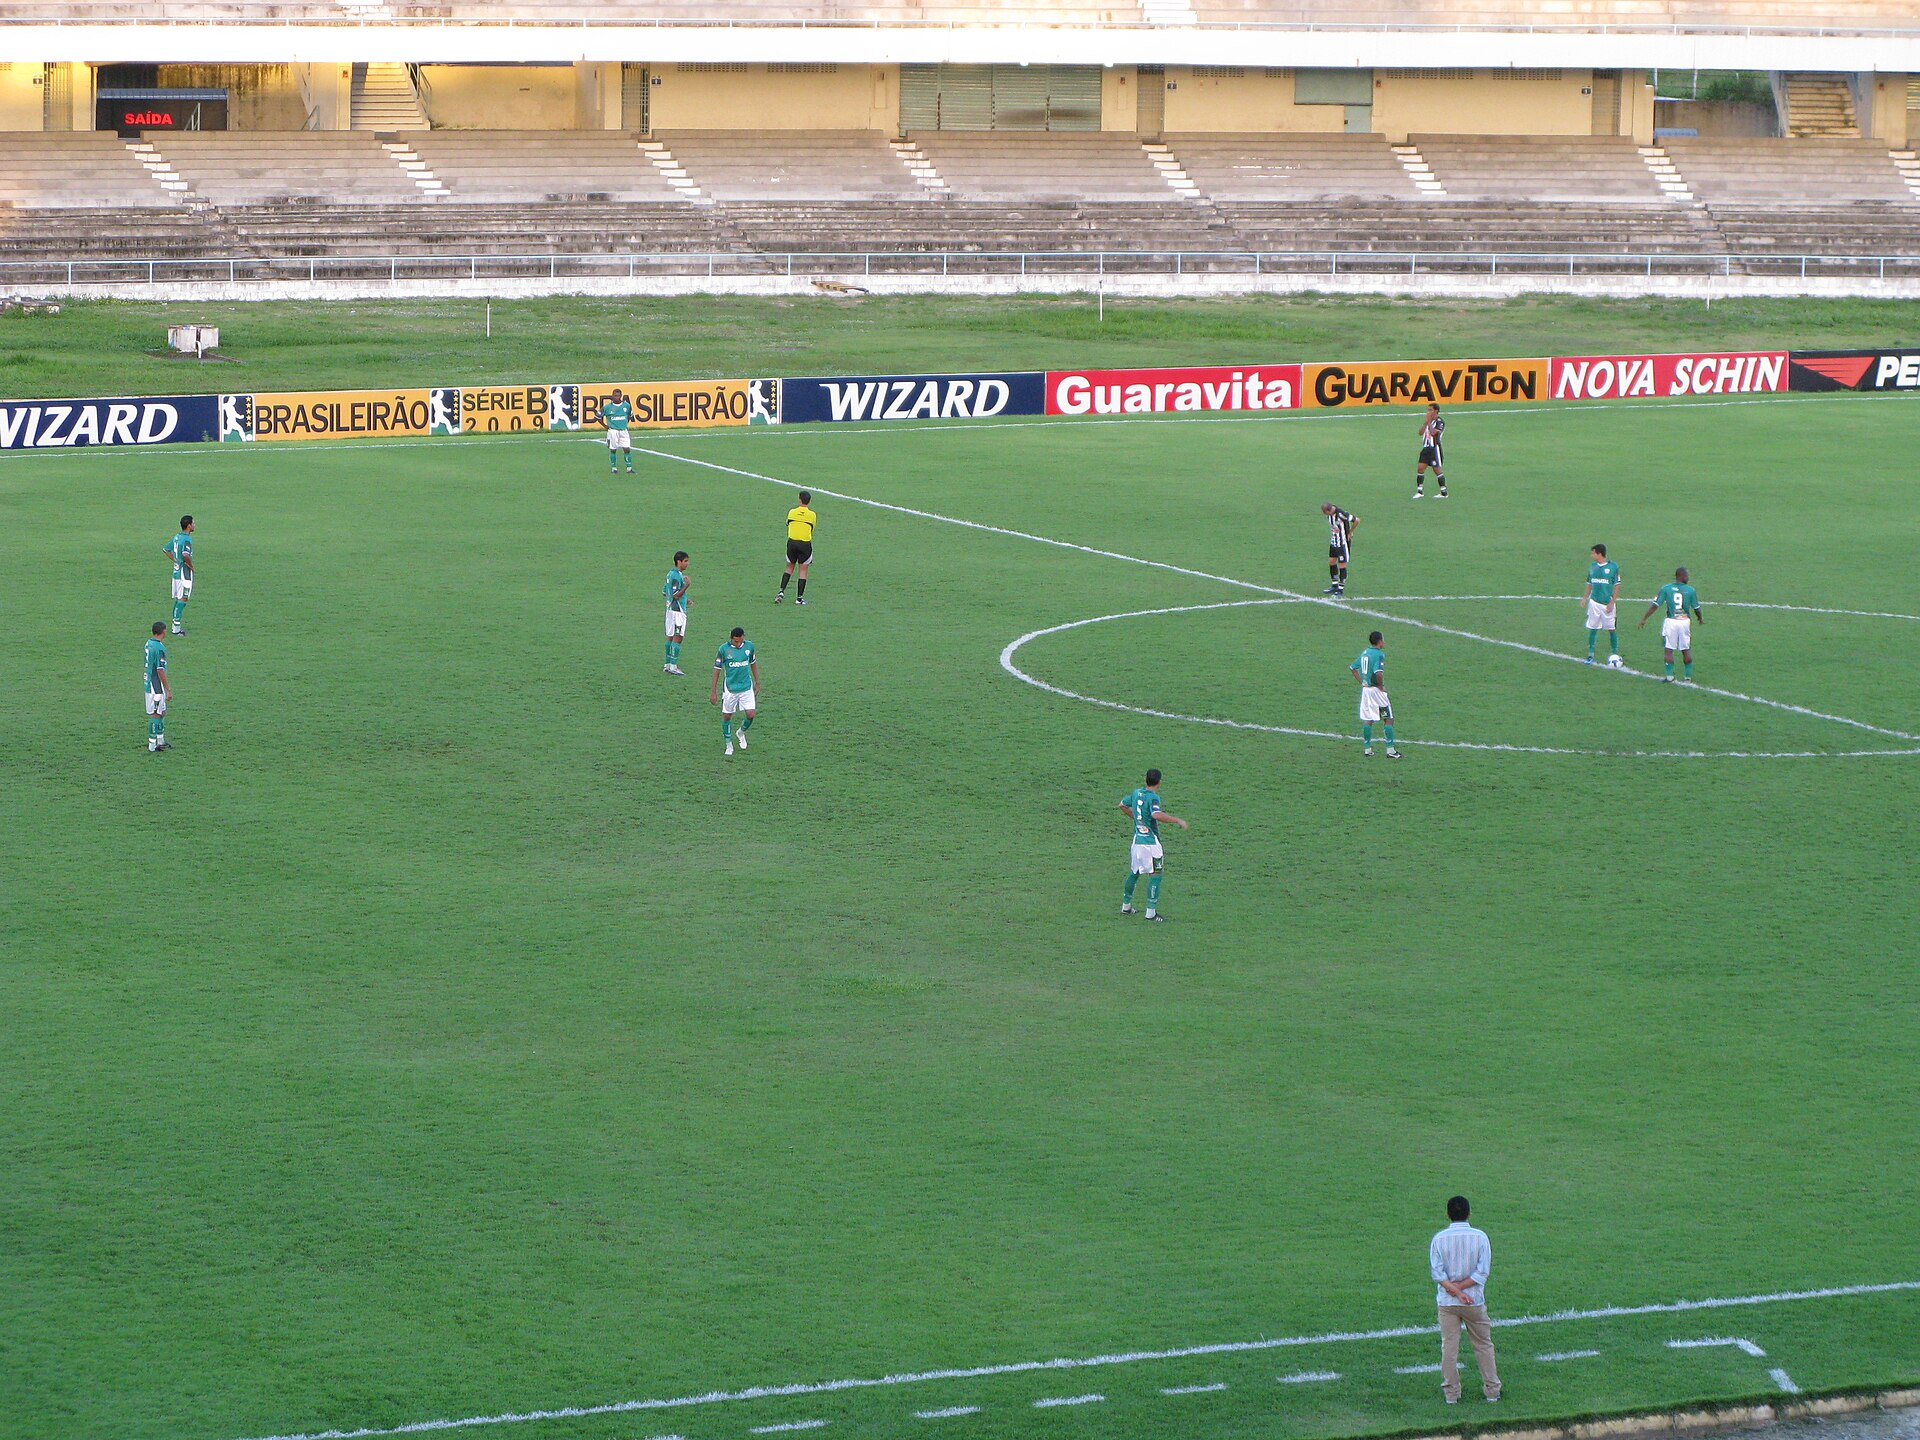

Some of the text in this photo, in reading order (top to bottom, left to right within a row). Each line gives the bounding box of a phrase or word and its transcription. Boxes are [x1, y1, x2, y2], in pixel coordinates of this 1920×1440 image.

[124, 110, 173, 125] SAÍDA
[1554, 355, 1785, 399] NOVA SCHIN
[1875, 355, 1920, 387] PE
[462, 386, 549, 415] SÉRIE B
[818, 379, 1010, 421] WIZARD
[1056, 371, 1292, 415] Guaravita
[255, 395, 429, 435] BRASILEIRÃO
[465, 415, 544, 432] 2009
[1673, 592, 1684, 611] 9
[1360, 655, 1370, 675] 10
